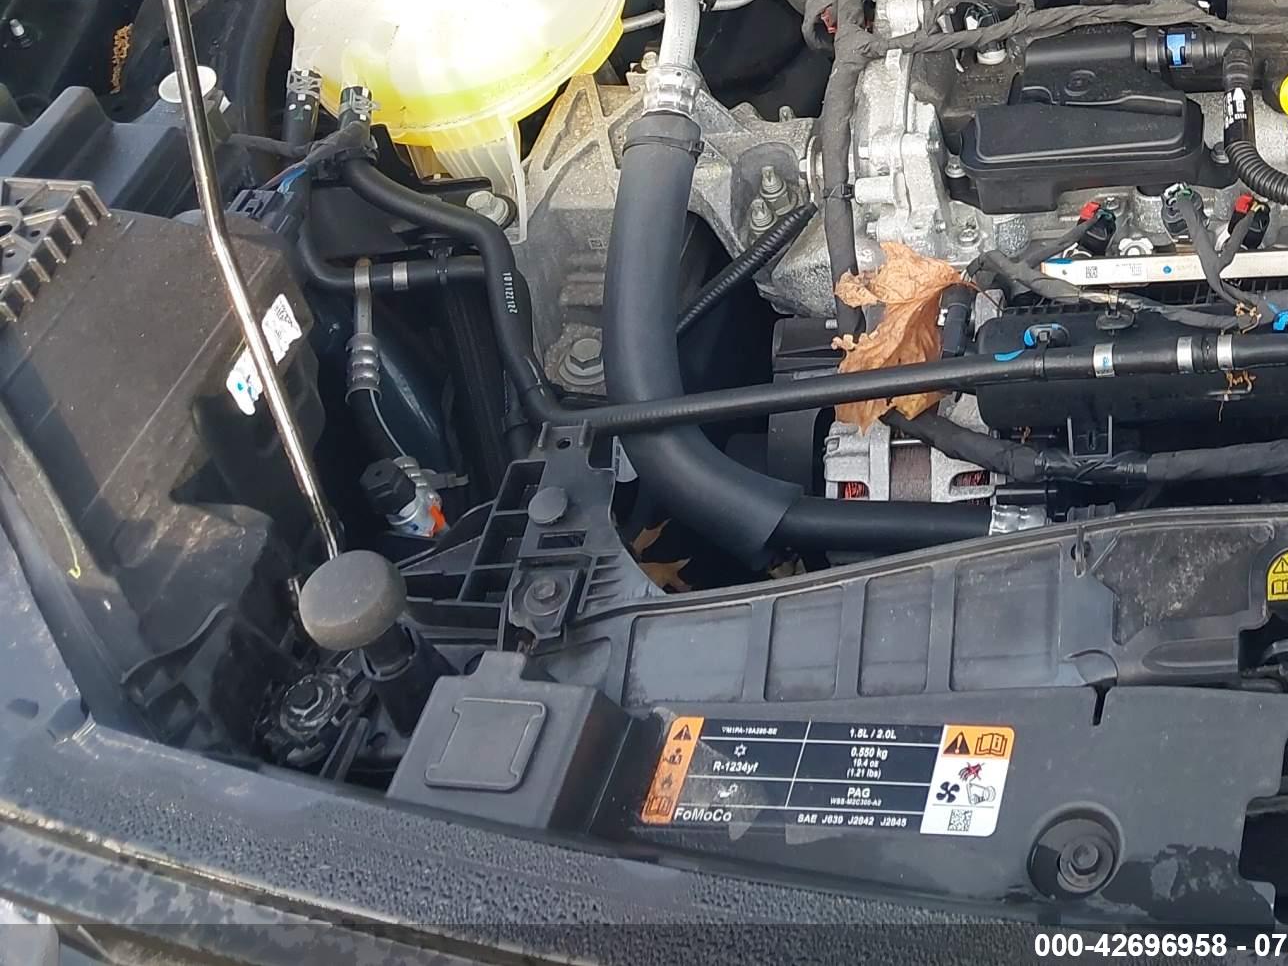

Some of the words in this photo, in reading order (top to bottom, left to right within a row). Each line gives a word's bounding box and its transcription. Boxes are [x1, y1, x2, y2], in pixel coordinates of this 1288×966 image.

[876, 728, 897, 740] 2.0L
[850, 746, 876, 758] 0.550
[876, 747, 889, 761] kg
[713, 760, 759, 775] R-1234yf
[869, 760, 880, 768] oz
[847, 786, 871, 798] PAG
[673, 807, 732, 822] FoMoCo
[797, 813, 818, 824] SAE
